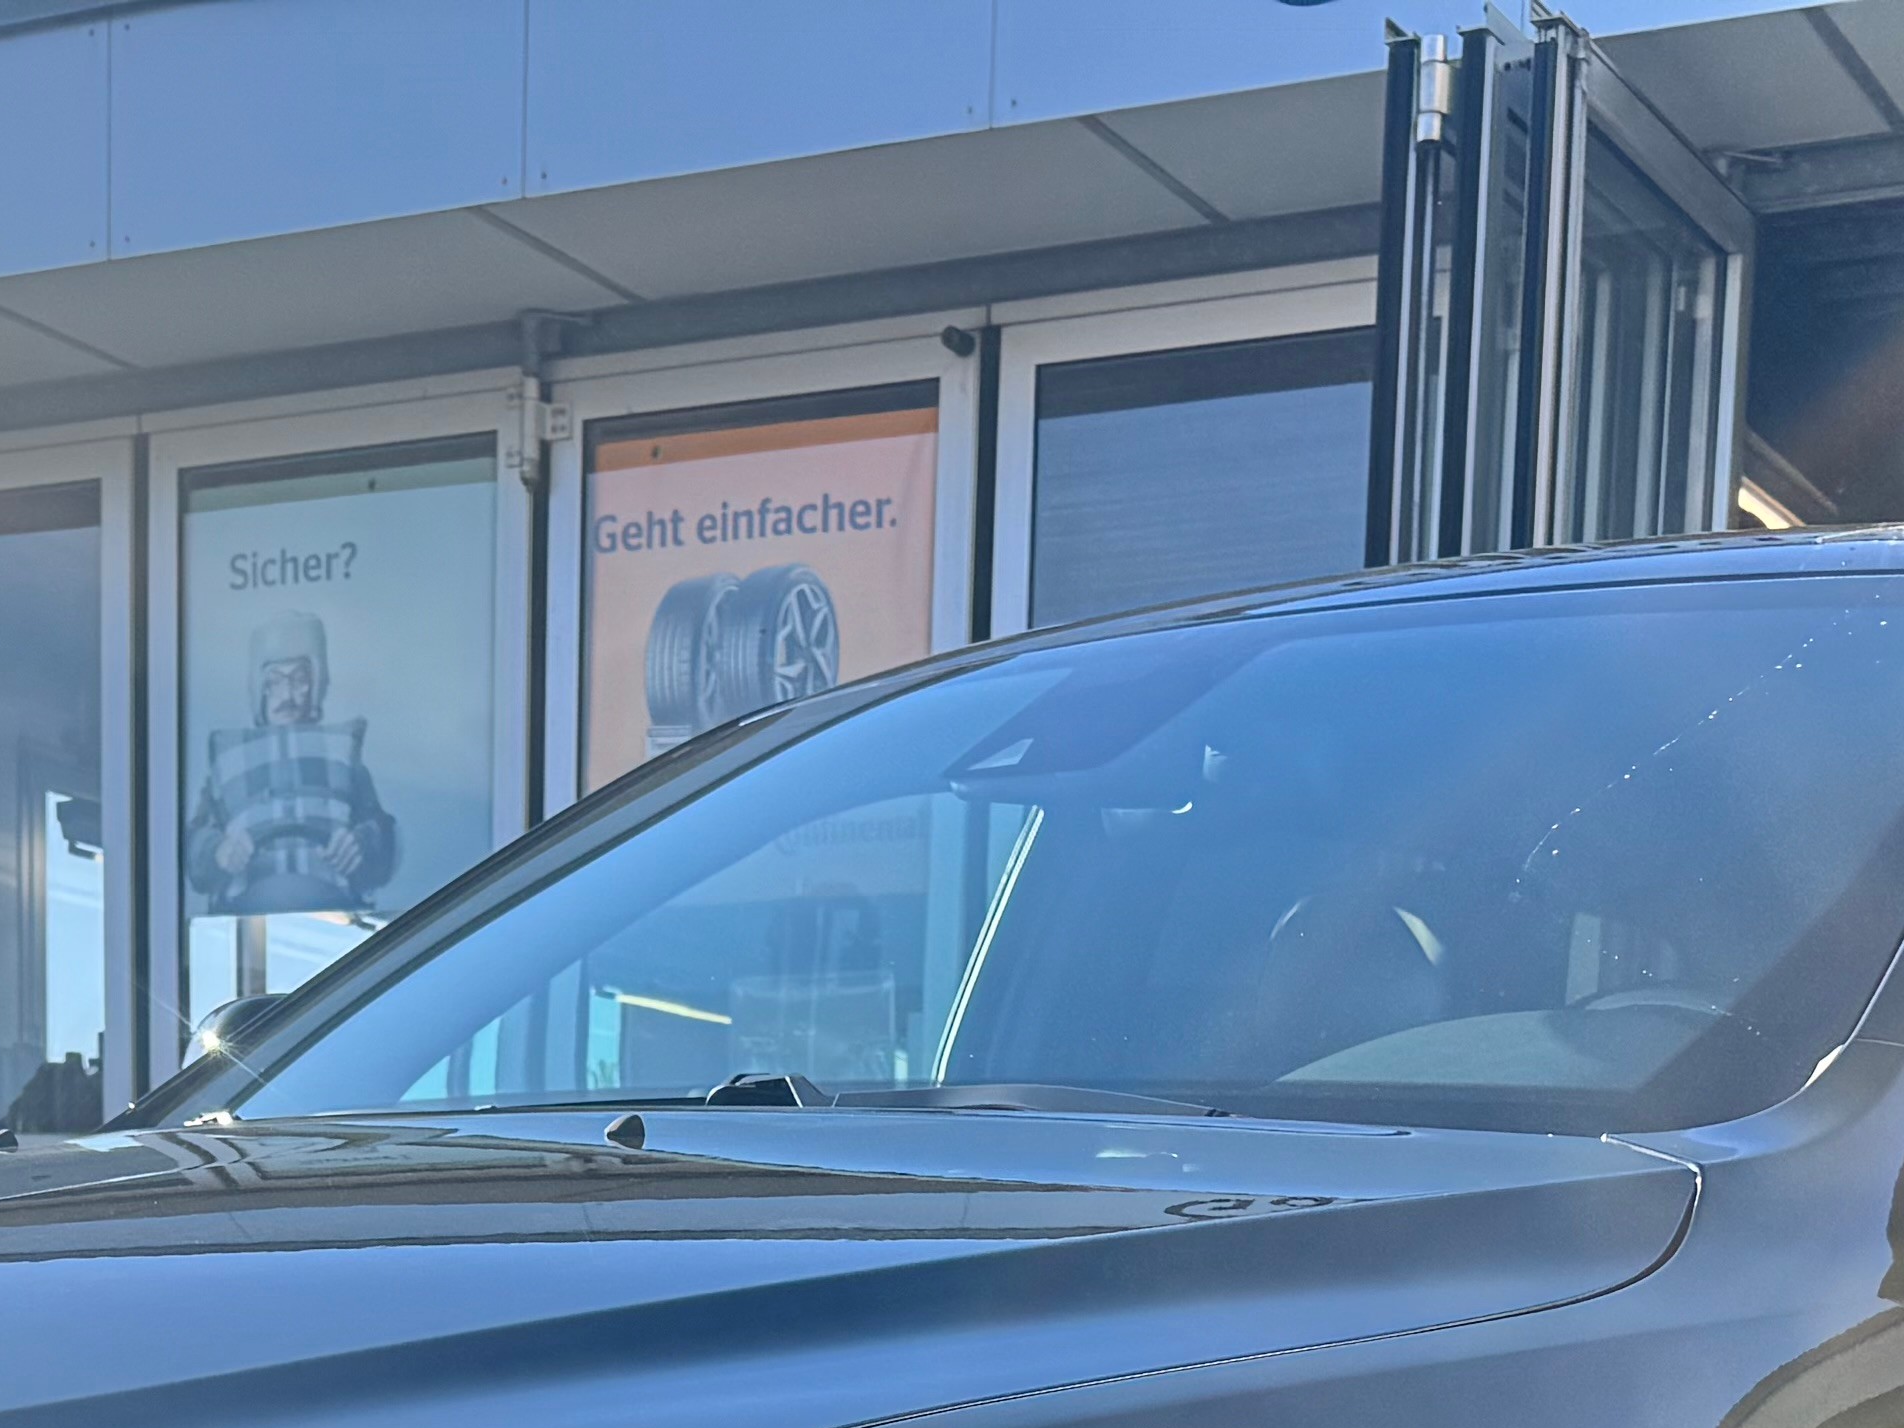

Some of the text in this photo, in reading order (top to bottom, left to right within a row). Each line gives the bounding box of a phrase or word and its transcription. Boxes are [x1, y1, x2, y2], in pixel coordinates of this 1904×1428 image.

[593, 493, 898, 555] Geht einfacher.
[228, 541, 359, 591] Sicher?
